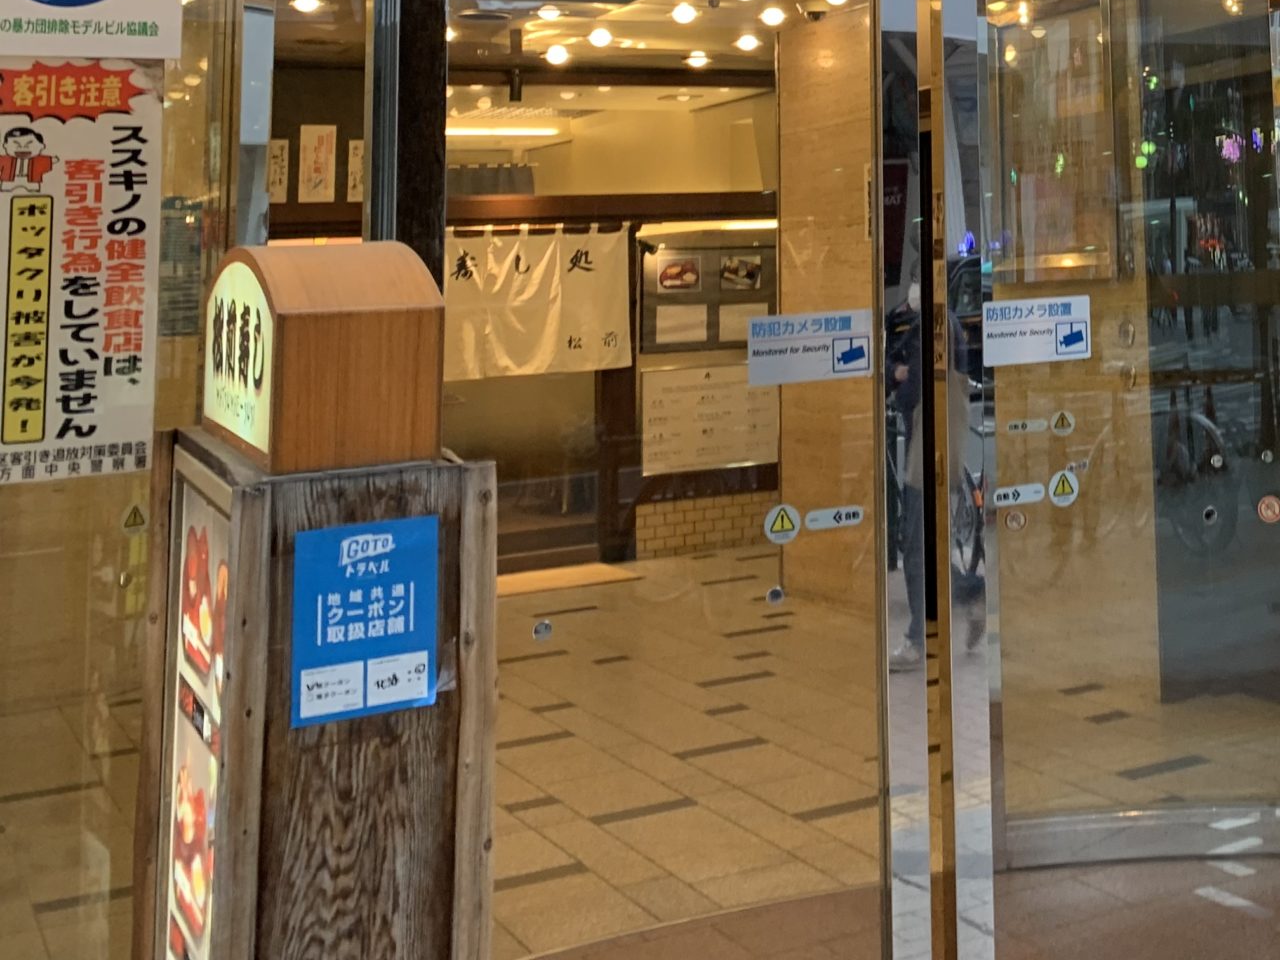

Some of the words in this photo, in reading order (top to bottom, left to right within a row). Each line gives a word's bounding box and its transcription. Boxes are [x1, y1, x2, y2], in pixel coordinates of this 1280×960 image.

[13, 75, 122, 107] 客引き注意
[102, 125, 149, 386] ススキノの健全飲食店は、
[55, 158, 105, 440] 客引き行為をしていません
[986, 302, 1073, 322] 防犯カメラ設置
[751, 315, 853, 338] 防犯カメラ設置
[987, 329, 1017, 340] Monitored
[1019, 329, 1028, 338] for
[1029, 327, 1055, 339] Security
[752, 346, 788, 358] Monitored
[790, 346, 800, 356] for
[802, 343, 831, 355] Security
[345, 558, 390, 578] トラベル
[327, 583, 404, 606] 地域共通
[327, 600, 405, 625] クーポン
[326, 617, 405, 644] 取扱店舗
